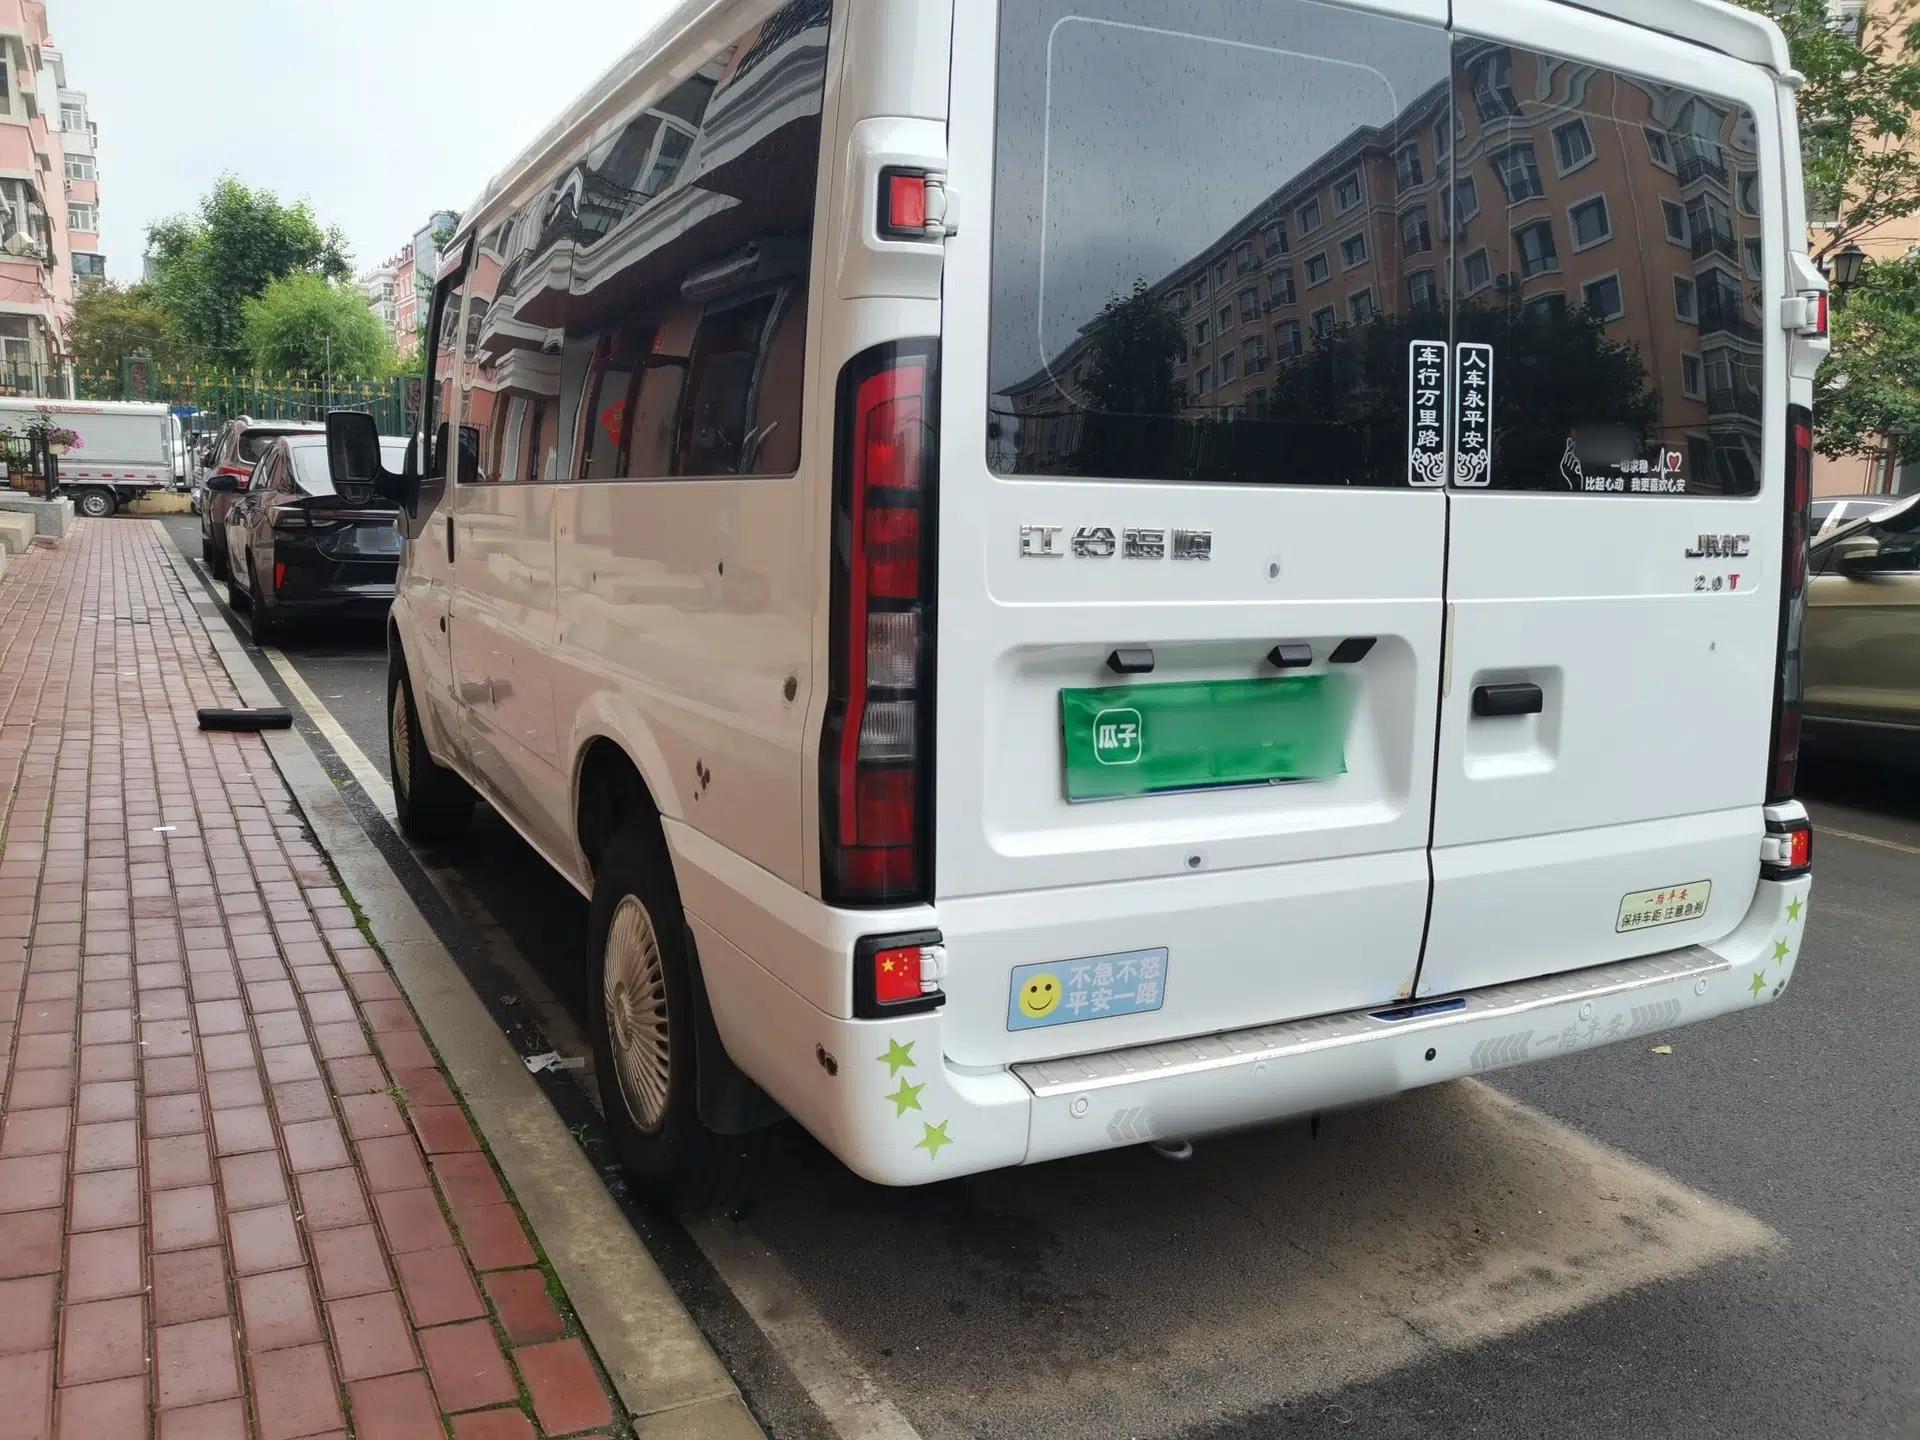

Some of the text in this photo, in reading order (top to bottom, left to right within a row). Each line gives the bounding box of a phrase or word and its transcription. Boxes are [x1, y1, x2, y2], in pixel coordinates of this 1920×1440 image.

[1416, 346, 1441, 447] 车行万里路
[1462, 349, 1487, 448] 人车永平安
[1585, 476, 1686, 492] 比起心动 我更喜欢心安
[1685, 533, 1751, 558] JMC
[1098, 723, 1137, 749] 瓜子
[1644, 888, 1688, 905] 一路平安
[1621, 908, 1662, 928] 保持车距
[1066, 982, 1158, 1016] 平安一路
